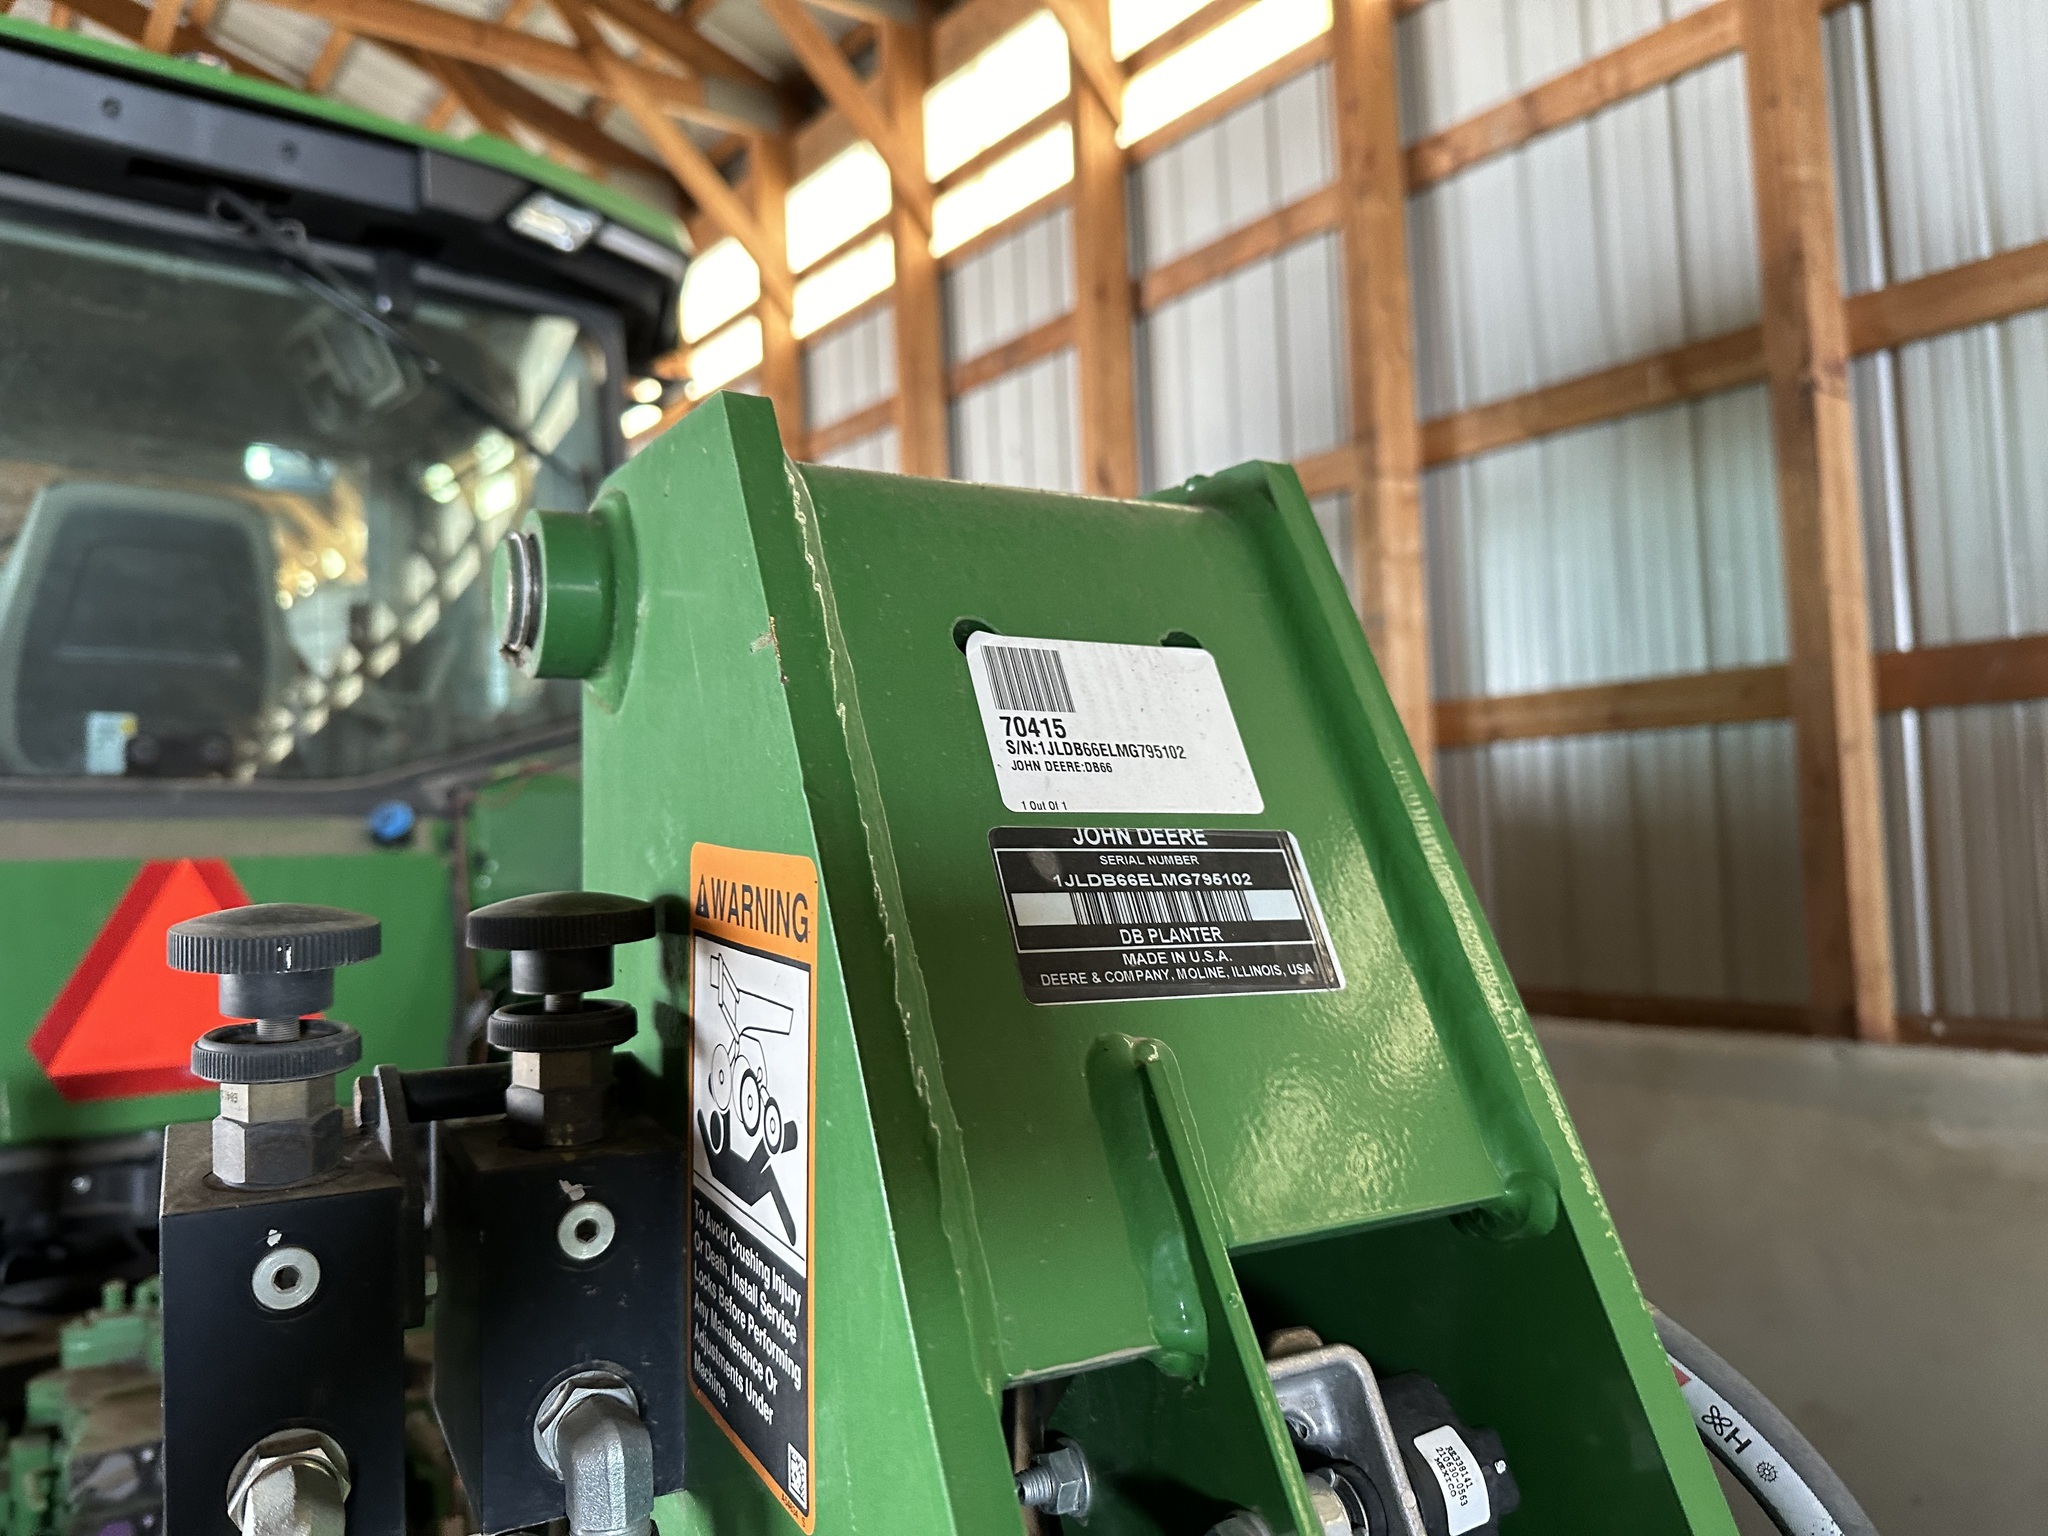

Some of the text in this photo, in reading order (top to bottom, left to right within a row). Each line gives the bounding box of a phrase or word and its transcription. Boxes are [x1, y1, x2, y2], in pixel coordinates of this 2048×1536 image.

[999, 716, 1067, 739] 70415
[1005, 739, 1187, 760] S/N:1JLDB66ELMG795102
[1011, 760, 1113, 773] JOHN DEERE:DB66
[1021, 801, 1028, 810] 1
[1029, 801, 1047, 811] Out
[1062, 801, 1068, 811] 1
[1072, 828, 1209, 846] JOHN DEERE
[1099, 855, 1200, 866] SERIAL NUMBER
[1053, 873, 1253, 888] 1JLDB66ELMG795102
[711, 877, 809, 944] WARNING
[1119, 926, 1224, 944] DB PLANTER
[1122, 948, 1233, 966] MADE IN U.S.A.
[1040, 962, 1315, 986] DEERE & COMPANY, MOLINE, ILLINOIS, USA
[694, 1199, 802, 1317] To Avoid Crushing Injury
[694, 1230, 798, 1345] Or Death, Install Service
[694, 1260, 802, 1392] Locks Before Performing
[694, 1291, 778, 1396] Any Maintenance Or
[694, 1321, 774, 1426] Adjustments Under
[694, 1350, 729, 1408] Machine.
[1433, 1457, 1457, 1498] MEXICO
[1435, 1446, 1469, 1507] 210630-0563
